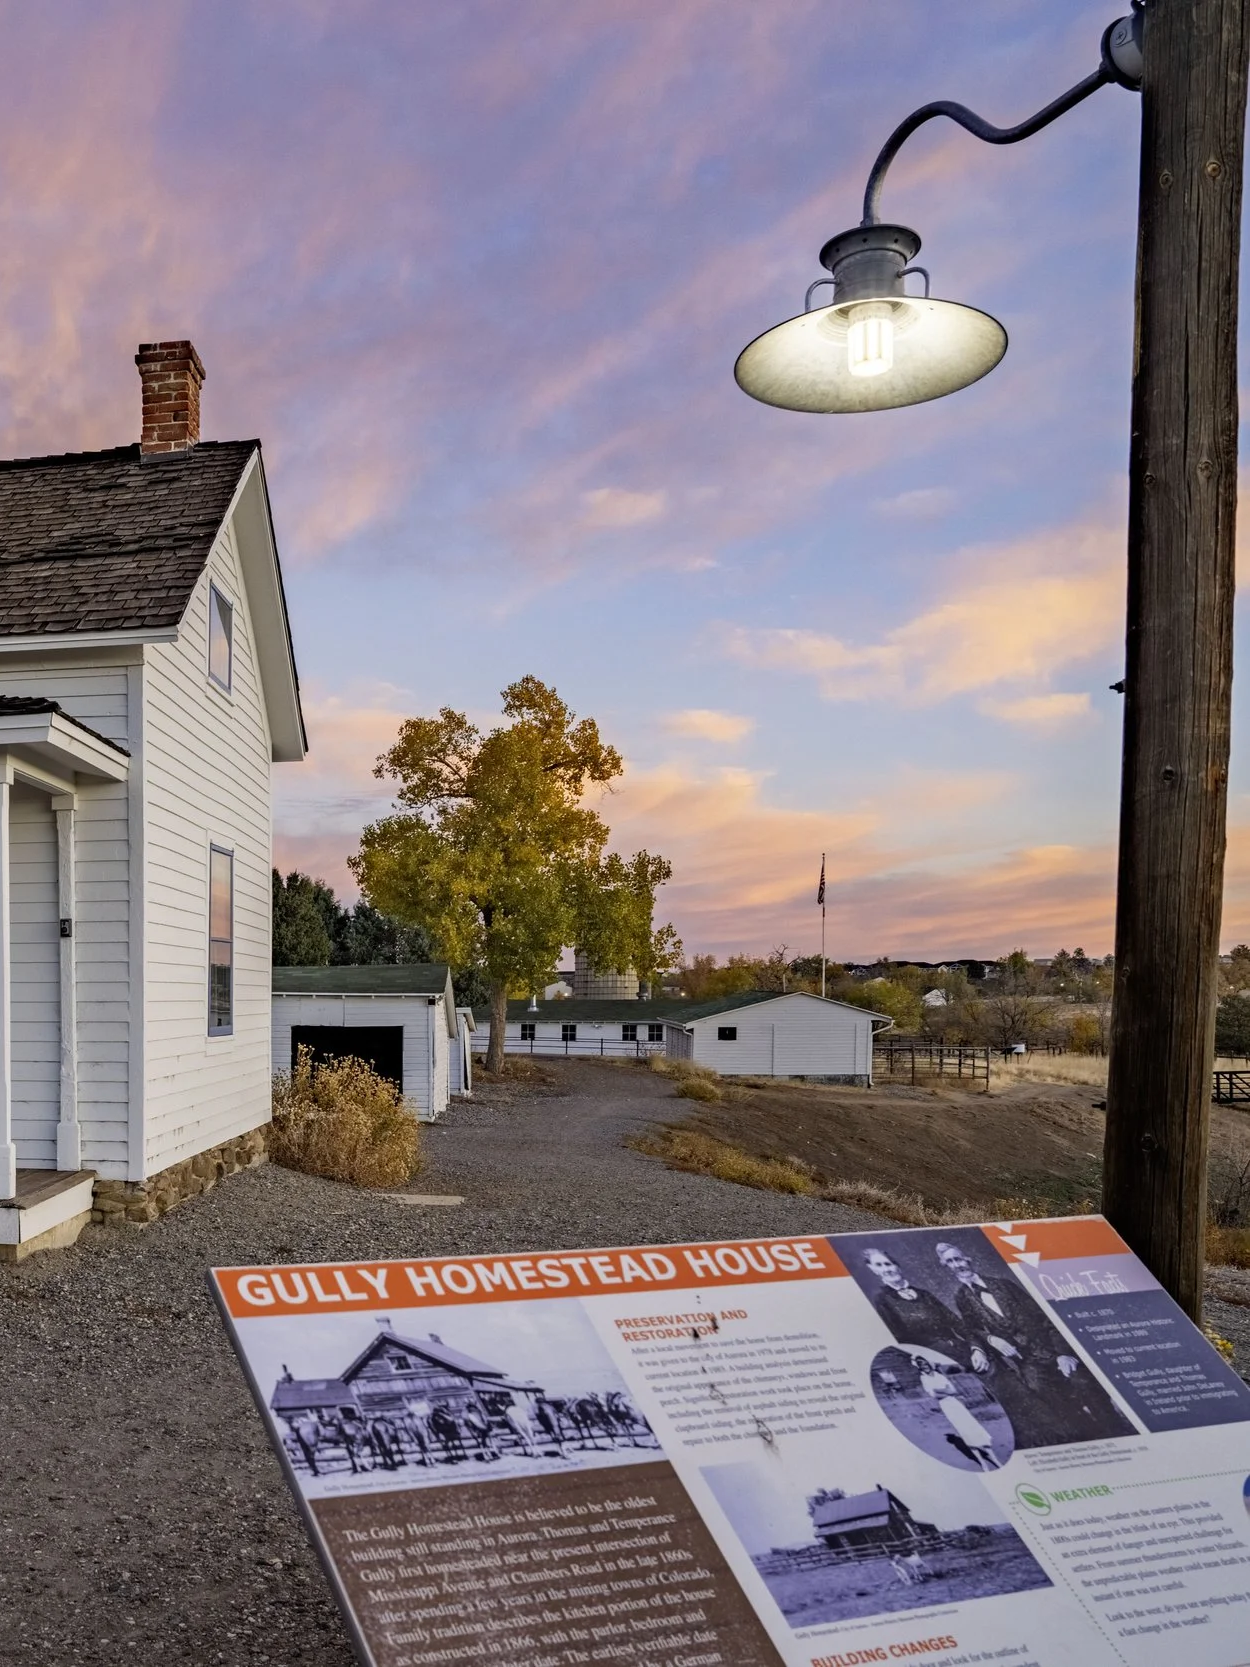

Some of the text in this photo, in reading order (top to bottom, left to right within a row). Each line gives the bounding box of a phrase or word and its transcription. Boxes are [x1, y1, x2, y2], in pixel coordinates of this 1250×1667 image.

[237, 1243, 824, 1306] GULLY HOMESTEAD HOUSE
[1038, 1270, 1128, 1300] Quick Facts
[615, 1309, 748, 1328] PRESERVATION AND
[622, 1324, 718, 1341] RESTORATION
[1050, 1485, 1113, 1502] WEATHER
[341, 1496, 657, 1543] The Gully Homestead House is believed to be the oldest
[351, 1547, 404, 1562] building
[405, 1542, 429, 1556] still
[430, 1538, 482, 1553] standing
[479, 1534, 496, 1547] in
[539, 1526, 588, 1539] Thomas
[588, 1519, 611, 1533] and
[609, 1514, 676, 1530] Temperance
[359, 1530, 672, 1583] Gully first homesteaded near the present intersection of
[368, 1549, 694, 1603] Mississippi Avenue and Chambers Road in the late 1860s
[376, 1610, 407, 1624] after
[409, 1603, 467, 1623] spending
[474, 1597, 498, 1613] few
[500, 1595, 533, 1610] years
[532, 1590, 548, 1604] in
[547, 1587, 567, 1600] the
[568, 1583, 610, 1597] mining
[609, 1579, 645, 1592] towns
[645, 1572, 659, 1586] of
[384, 1589, 716, 1646] Family tradition describes the kitchen portion of the house
[395, 1655, 412, 1667] as
[413, 1641, 487, 1664] constructed
[486, 1639, 502, 1653] in
[539, 1630, 569, 1644] with
[569, 1627, 590, 1641] the
[630, 1615, 684, 1631] bedroom
[684, 1608, 707, 1623] and
[562, 1650, 590, 1664] The
[591, 1643, 636, 1660] earliest
[636, 1633, 692, 1651] verifiable
[693, 1630, 718, 1643] date
[674, 1652, 722, 1667] German
[811, 1635, 958, 1667] BUILDING CHANGES
